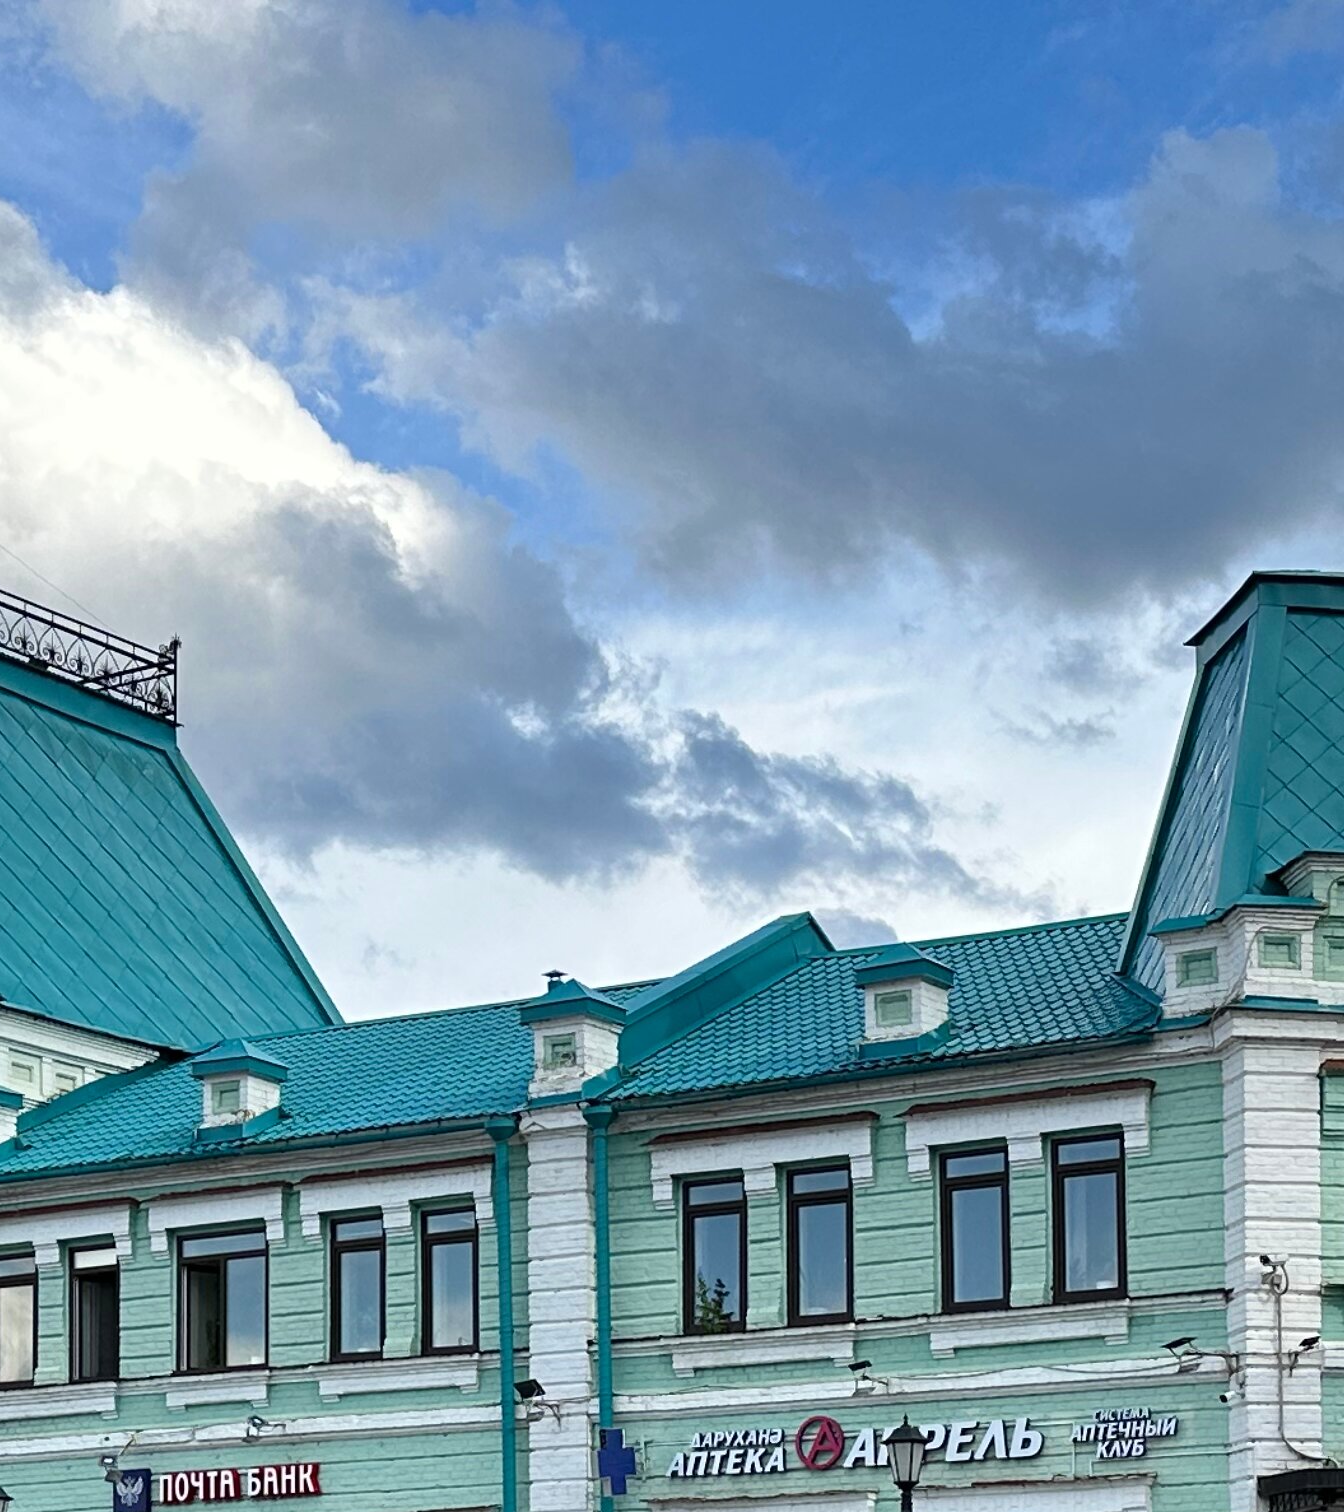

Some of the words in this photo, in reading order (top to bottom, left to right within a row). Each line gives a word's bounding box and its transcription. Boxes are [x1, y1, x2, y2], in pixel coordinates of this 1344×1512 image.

[1093, 1407, 1150, 1422] СИСТЕМА
[691, 1428, 783, 1448] ДАРУХАНӘ
[1071, 1416, 1177, 1442] АПТЕЧНЫЙ
[1096, 1438, 1146, 1459] КЛУБ
[666, 1446, 785, 1477] АПТЕКА
[159, 1469, 236, 1503] ПОЧТА
[247, 1464, 315, 1497] БАНК
